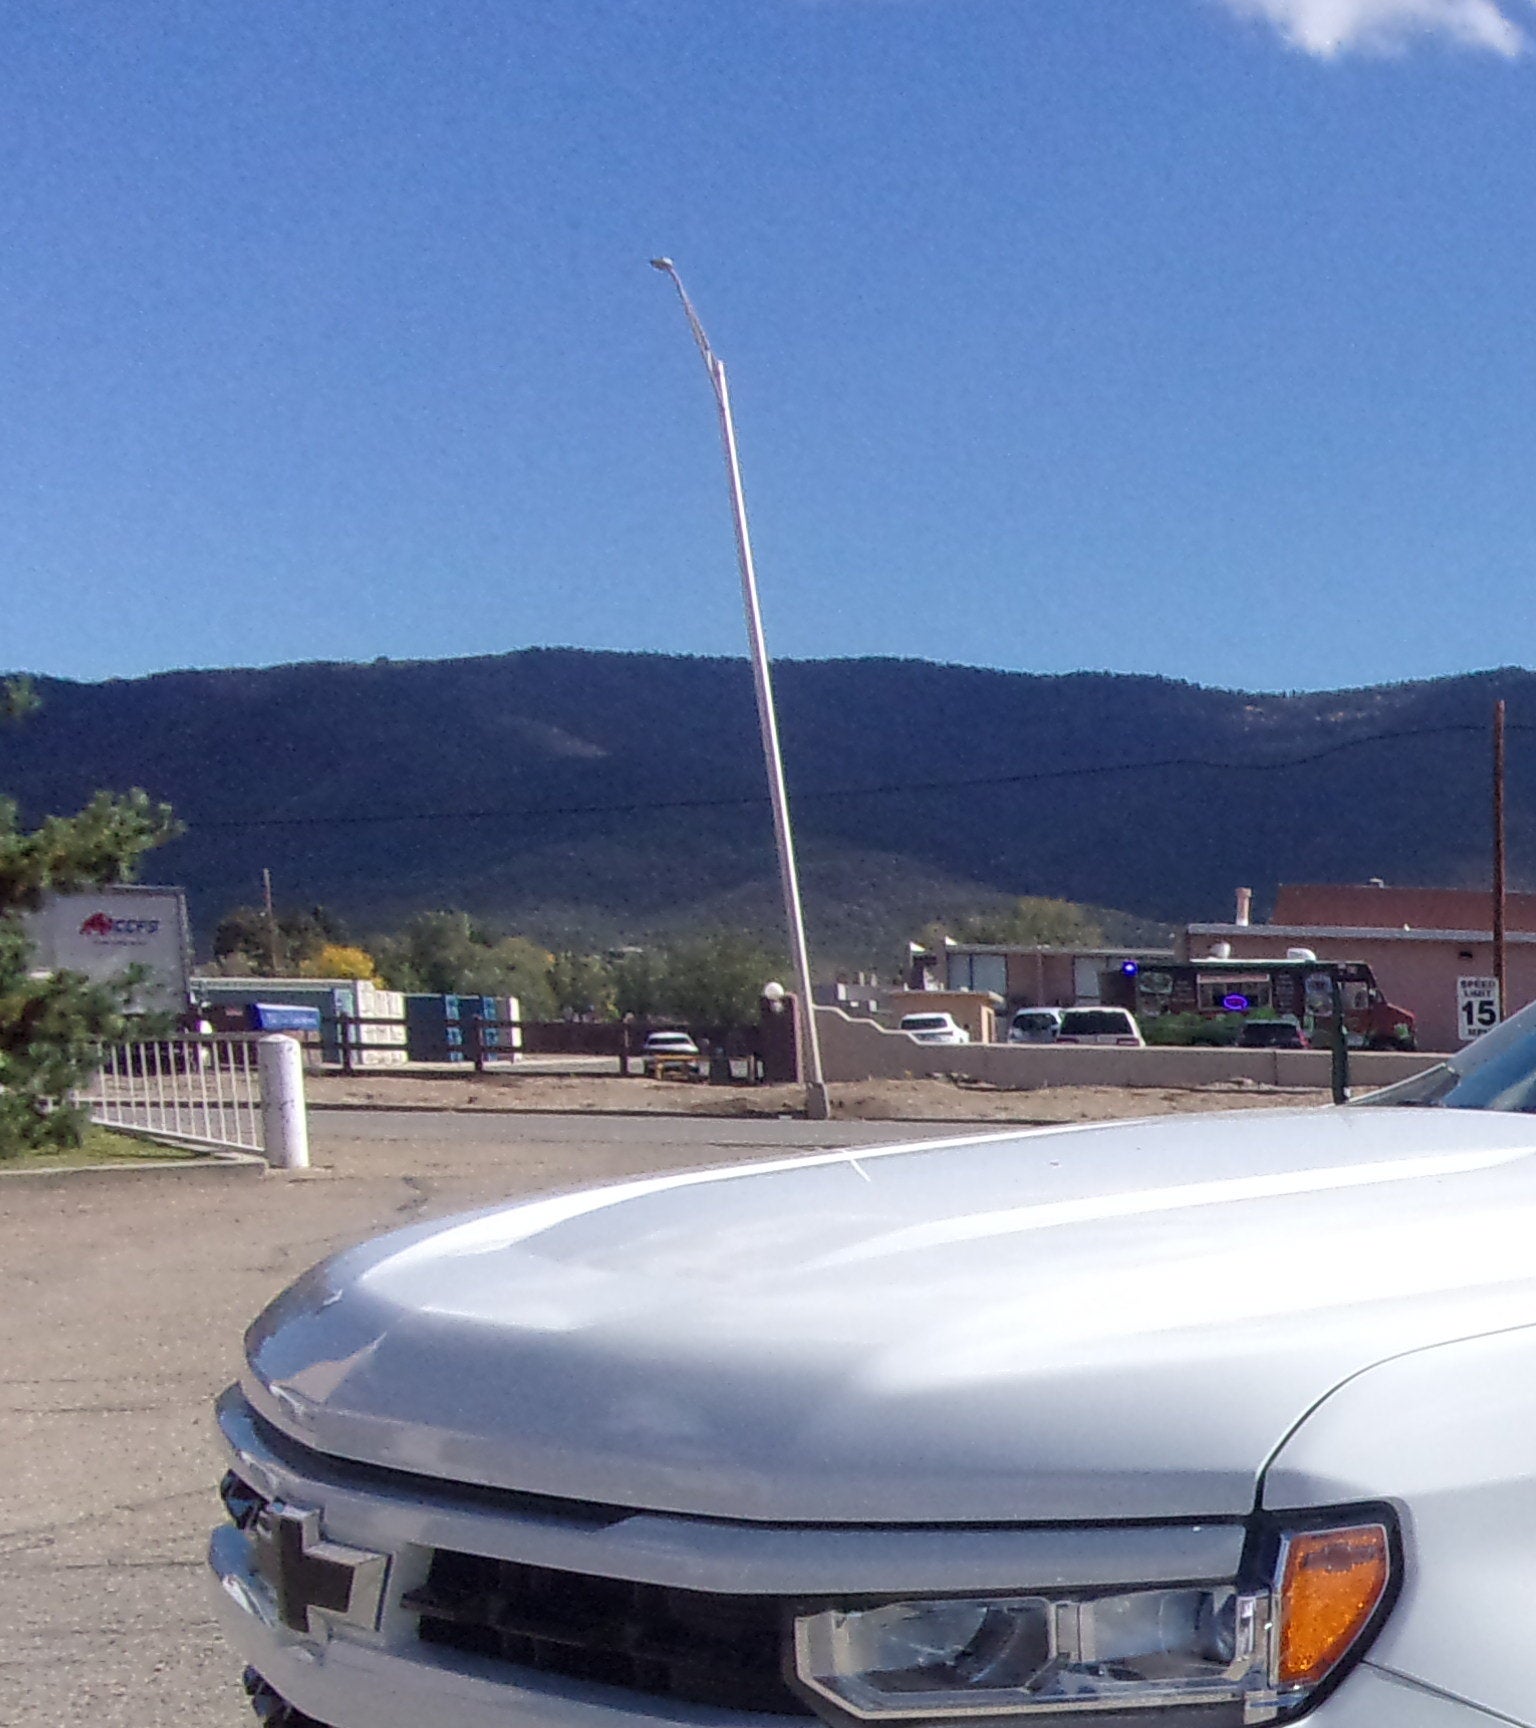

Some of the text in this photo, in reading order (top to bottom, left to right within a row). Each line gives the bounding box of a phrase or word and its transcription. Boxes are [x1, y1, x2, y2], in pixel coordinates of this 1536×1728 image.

[1460, 980, 1497, 989] SPEED
[1463, 989, 1492, 998] LIMIT
[1461, 1000, 1497, 1027] 15
